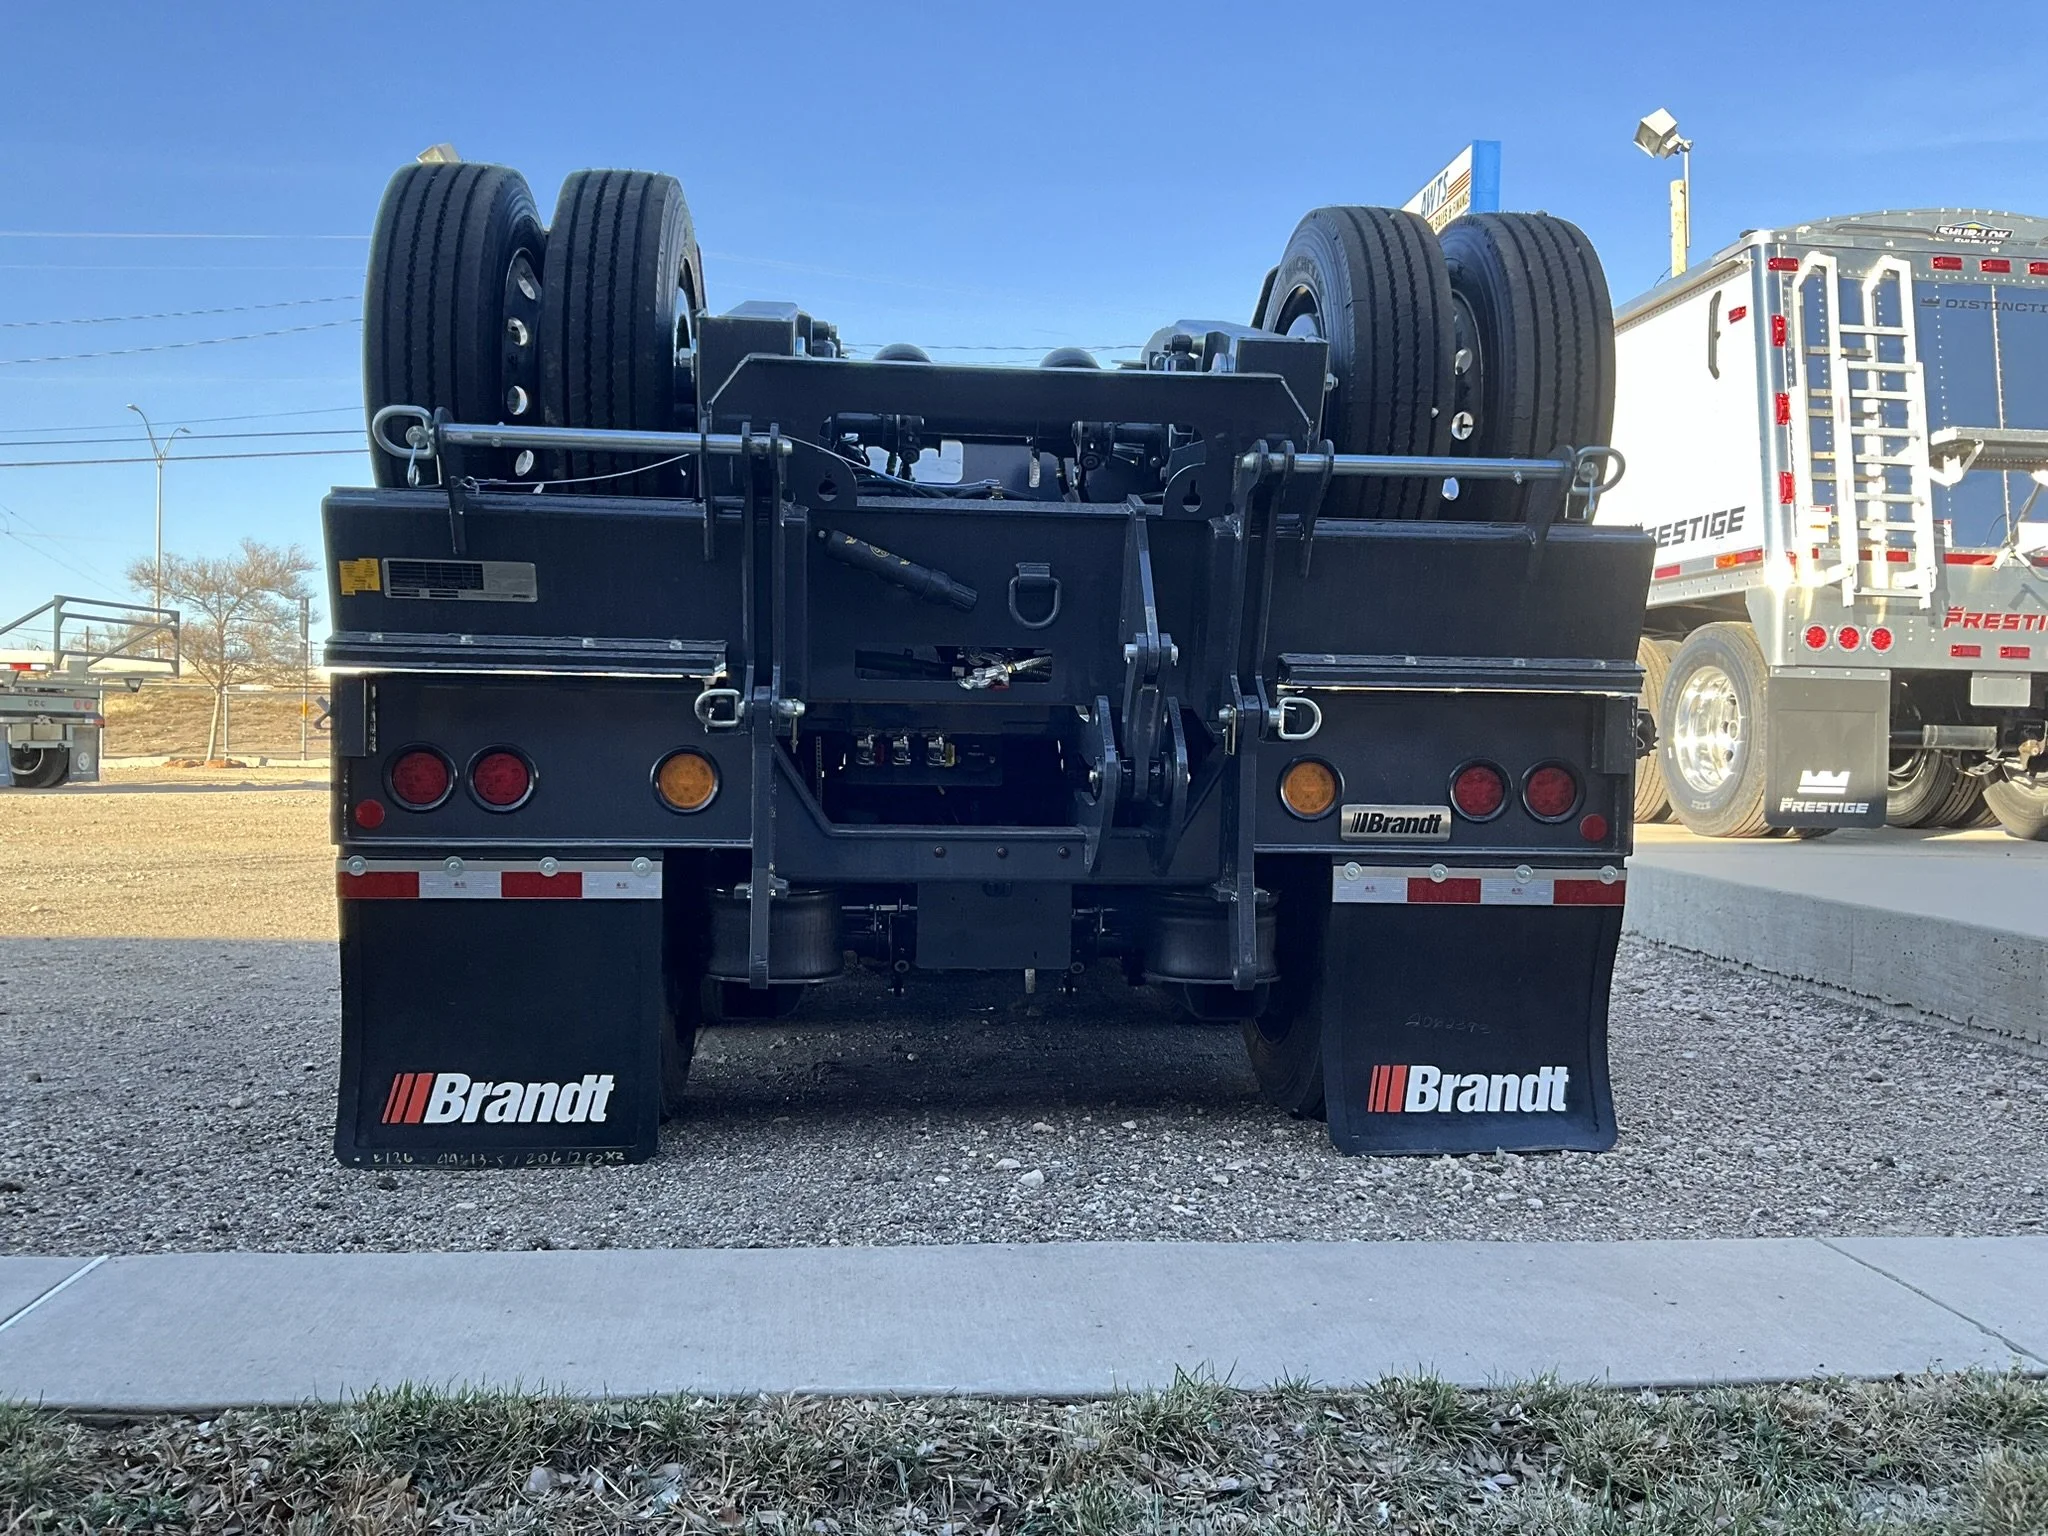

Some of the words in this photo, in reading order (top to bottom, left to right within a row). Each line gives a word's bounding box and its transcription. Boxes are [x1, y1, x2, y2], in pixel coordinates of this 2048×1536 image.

[1945, 299, 2048, 313] DISTINCTI
[1645, 506, 1746, 548] RESTIGE
[1943, 611, 2048, 631] PRESTI
[1779, 800, 1869, 814] PRESTIGE
[1366, 813, 1442, 833] Brandt
[424, 1073, 615, 1123] Brandt
[1405, 1065, 1569, 1112] Brandt
